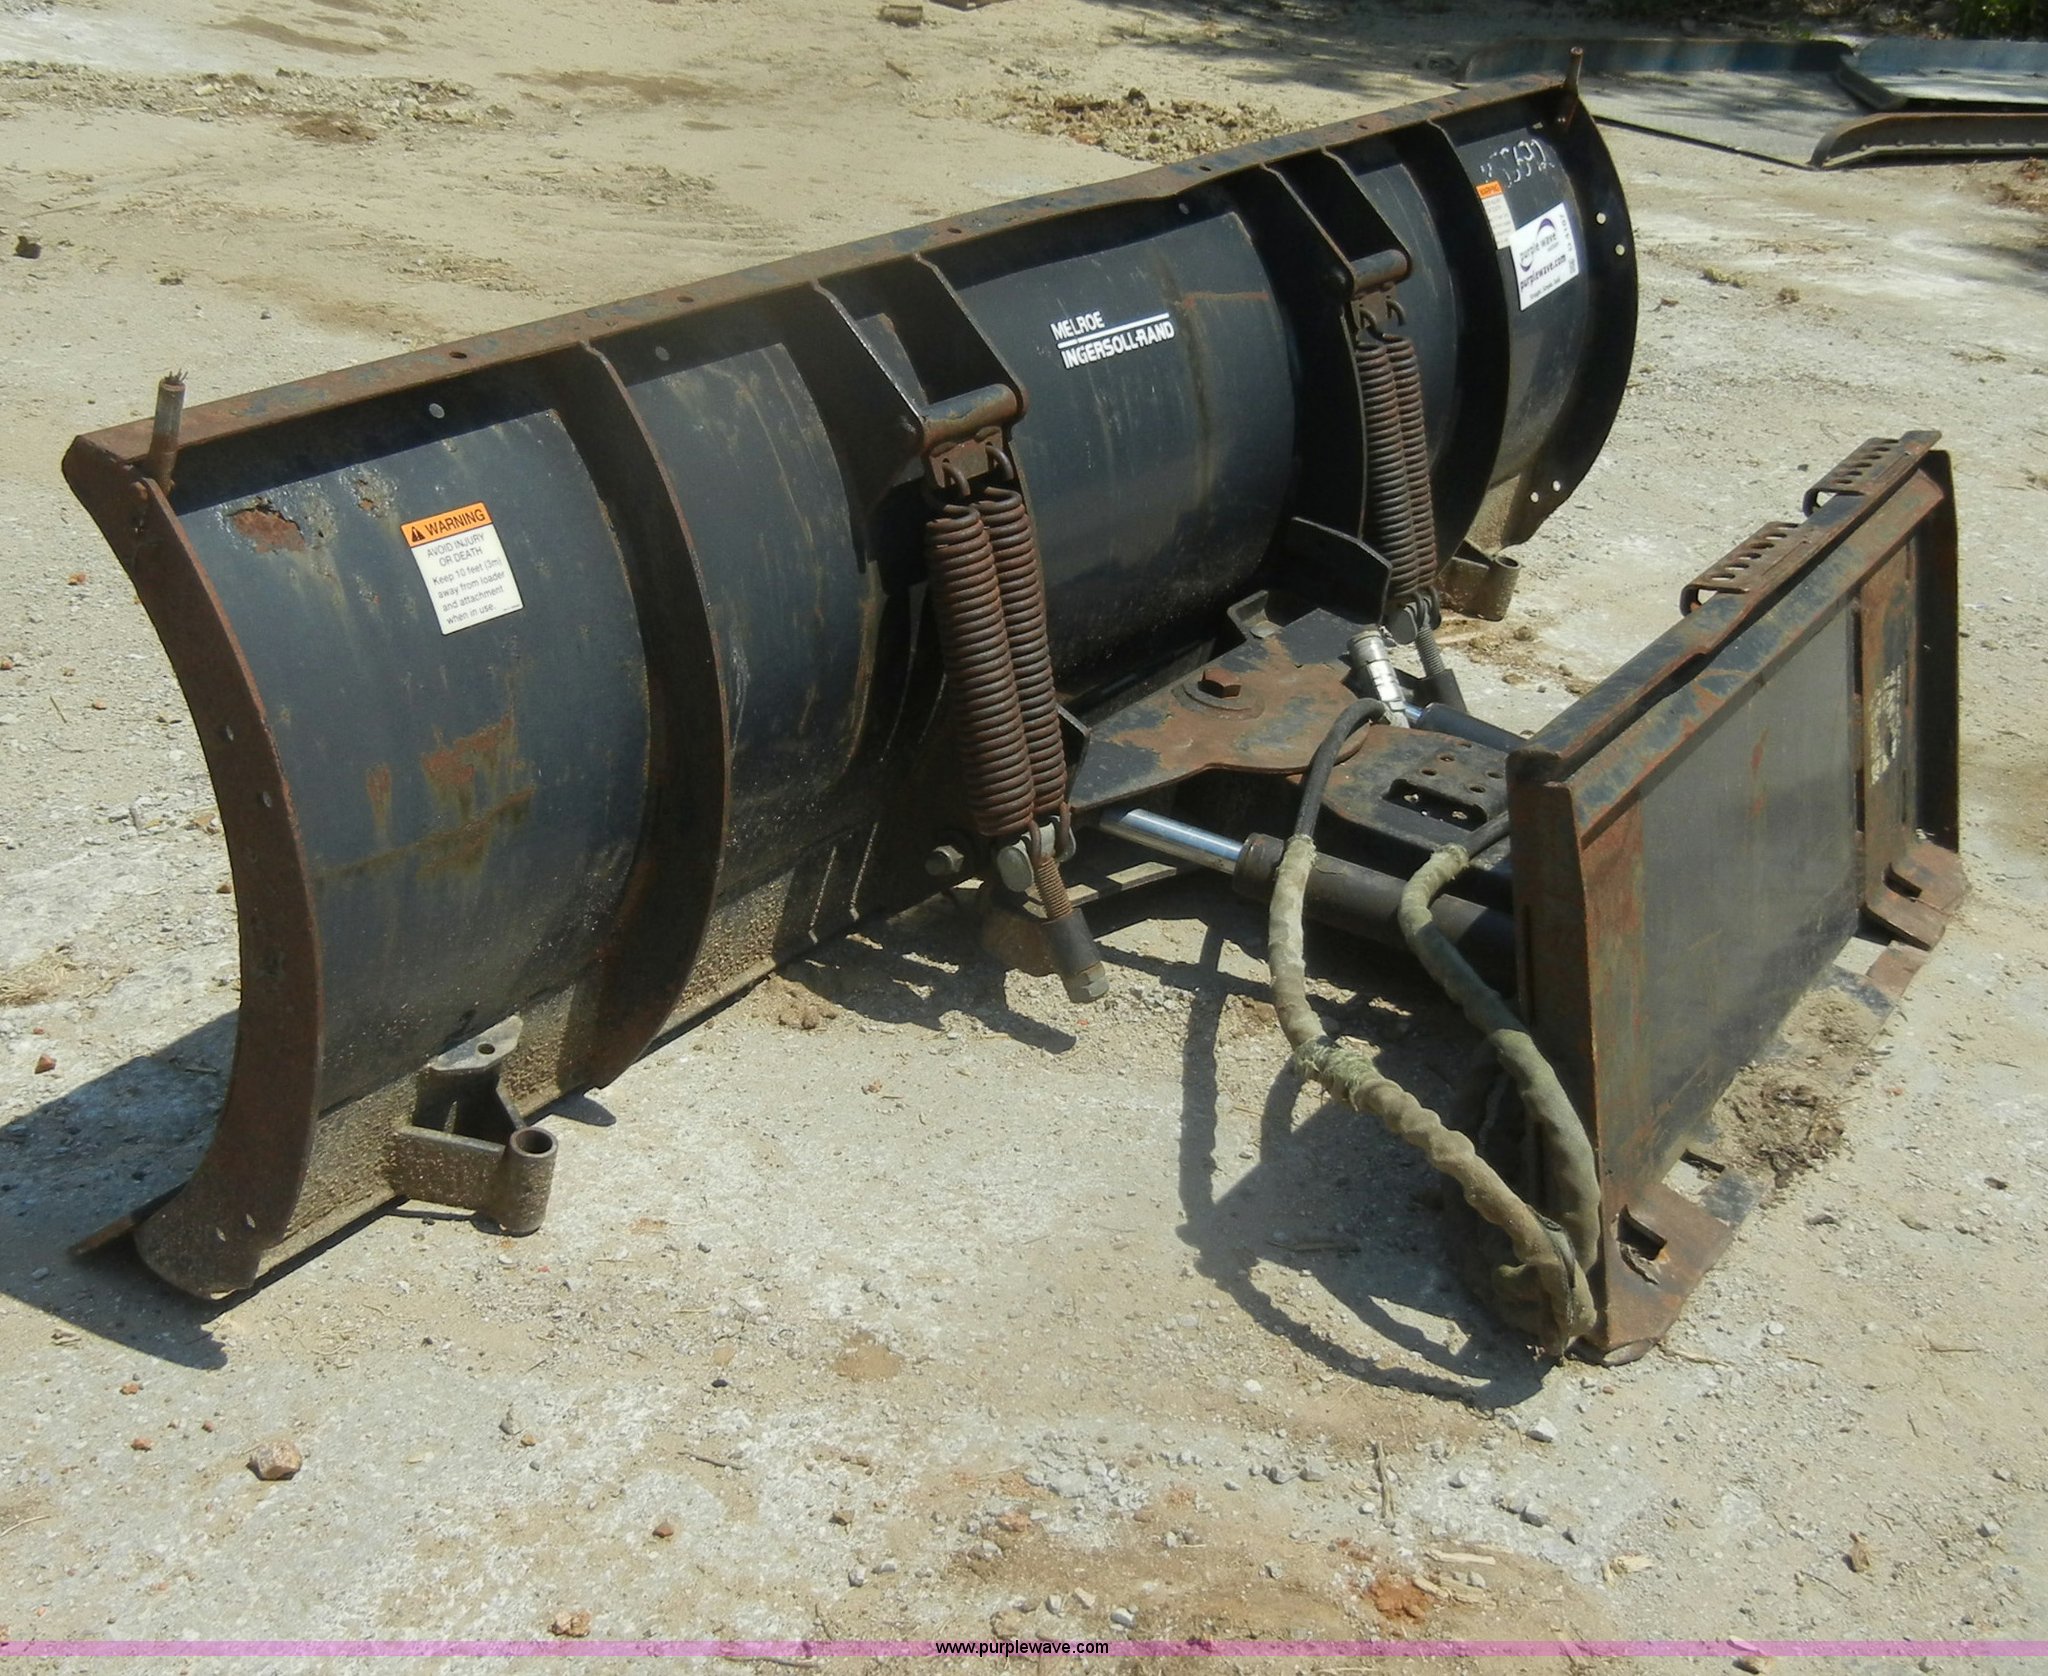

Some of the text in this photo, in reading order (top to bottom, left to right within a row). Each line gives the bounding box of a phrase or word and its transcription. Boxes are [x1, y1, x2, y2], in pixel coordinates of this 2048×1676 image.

[1520, 240, 1540, 262] purple
[1541, 232, 1557, 247] wave
[1519, 253, 1567, 293] purplewave.com
[1050, 310, 1105, 341] MELROE
[1061, 320, 1175, 369] INGERSOLL-RAND
[425, 509, 486, 536] WARNING
[427, 532, 485, 558] AVOID INJURY
[439, 548, 483, 567] OR DEATH
[433, 572, 455, 586] Keep
[456, 568, 466, 578] 10
[466, 563, 483, 575] feet
[438, 570, 505, 600] away from loader
[442, 585, 504, 612] and attachment
[446, 609, 469, 625] when
[470, 606, 479, 617] in
[480, 602, 496, 613] use.
